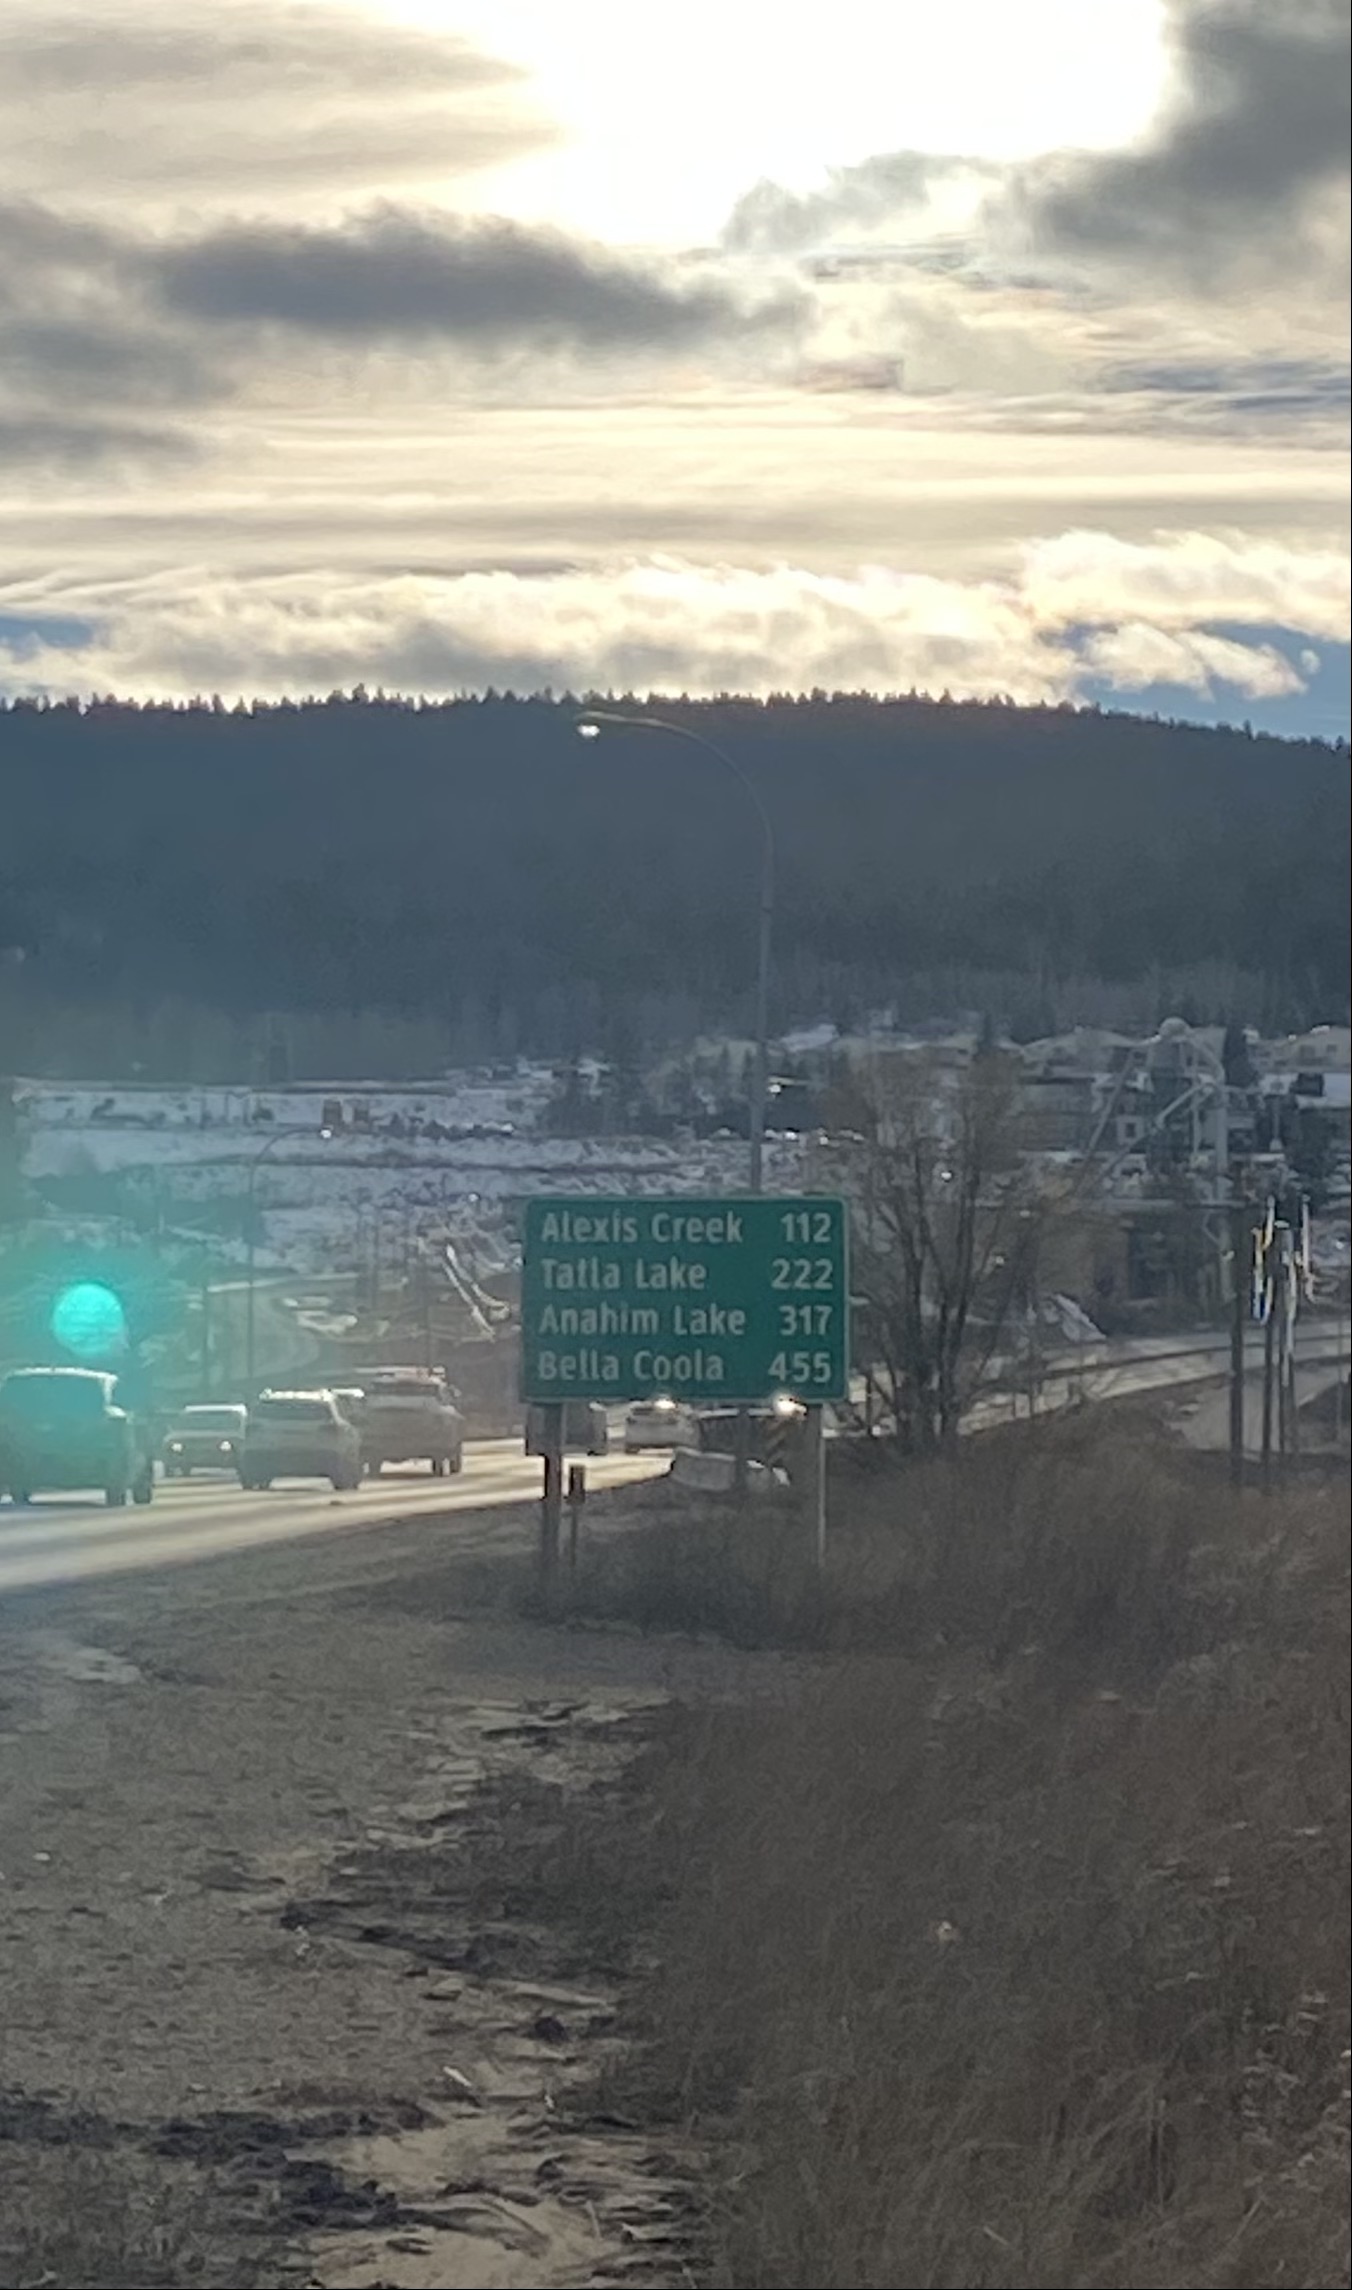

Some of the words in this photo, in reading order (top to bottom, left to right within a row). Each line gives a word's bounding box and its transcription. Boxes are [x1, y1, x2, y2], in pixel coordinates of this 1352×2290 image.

[541, 1210, 638, 1243] Alexis
[651, 1211, 743, 1243] Creek
[780, 1212, 831, 1243] 112
[541, 1257, 620, 1290] Tatla
[635, 1257, 707, 1290] Lake
[771, 1258, 833, 1290] 222
[539, 1302, 658, 1335] Anahim
[673, 1304, 746, 1335] Lake
[779, 1306, 833, 1336] 317
[538, 1349, 620, 1382] Bella
[633, 1349, 724, 1382] Coola
[768, 1352, 831, 1383] 455
